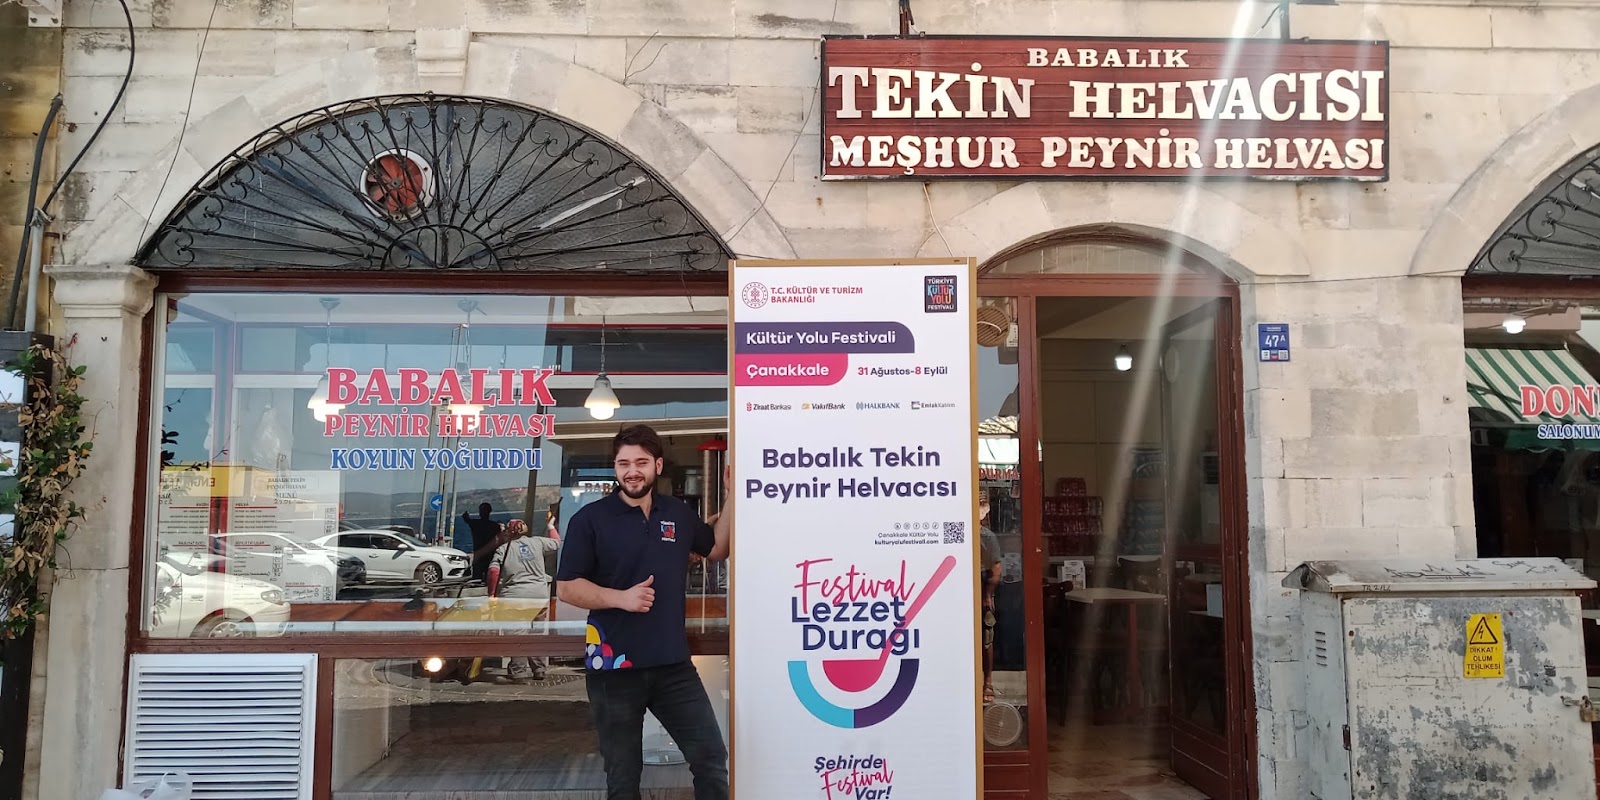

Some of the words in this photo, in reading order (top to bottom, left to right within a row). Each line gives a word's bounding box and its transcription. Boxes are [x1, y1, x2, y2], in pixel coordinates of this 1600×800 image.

[1027, 47, 1189, 68] BABALIK
[828, 62, 1035, 119] TEKİN
[1068, 69, 1385, 121] HELVACISI
[829, 135, 1020, 175] MEŞHUR
[1041, 128, 1203, 170] PEYNİR
[1214, 137, 1385, 170] HELVASI
[771, 295, 815, 303] BAKANLIĞI
[786, 286, 818, 294] KÜLTÜR
[832, 286, 863, 294] TURİZM
[931, 295, 951, 304] YOLU
[746, 332, 794, 345] Kültür
[797, 331, 828, 345] Yolu
[831, 331, 896, 344] Festivali
[746, 363, 830, 378] Çanakkale
[858, 366, 869, 376] 31
[924, 366, 948, 377] Eylül
[325, 367, 556, 407] BABALIK
[1519, 384, 1600, 418] DON
[323, 408, 430, 438] PEYNİR
[438, 413, 555, 438] HELVASI
[331, 448, 415, 470] KOYUN
[422, 442, 542, 470] YOĞURDU
[762, 446, 864, 468] Babalık
[870, 446, 940, 467] Tekin
[746, 477, 830, 504] Peynir
[838, 477, 957, 498] Helvacısı
[794, 558, 915, 614] Festival
[791, 596, 906, 623] Lezzet
[802, 622, 920, 656] Durağı
[814, 754, 883, 773] Şehirde
[820, 758, 894, 800] Festival
[854, 785, 892, 800] Var!
